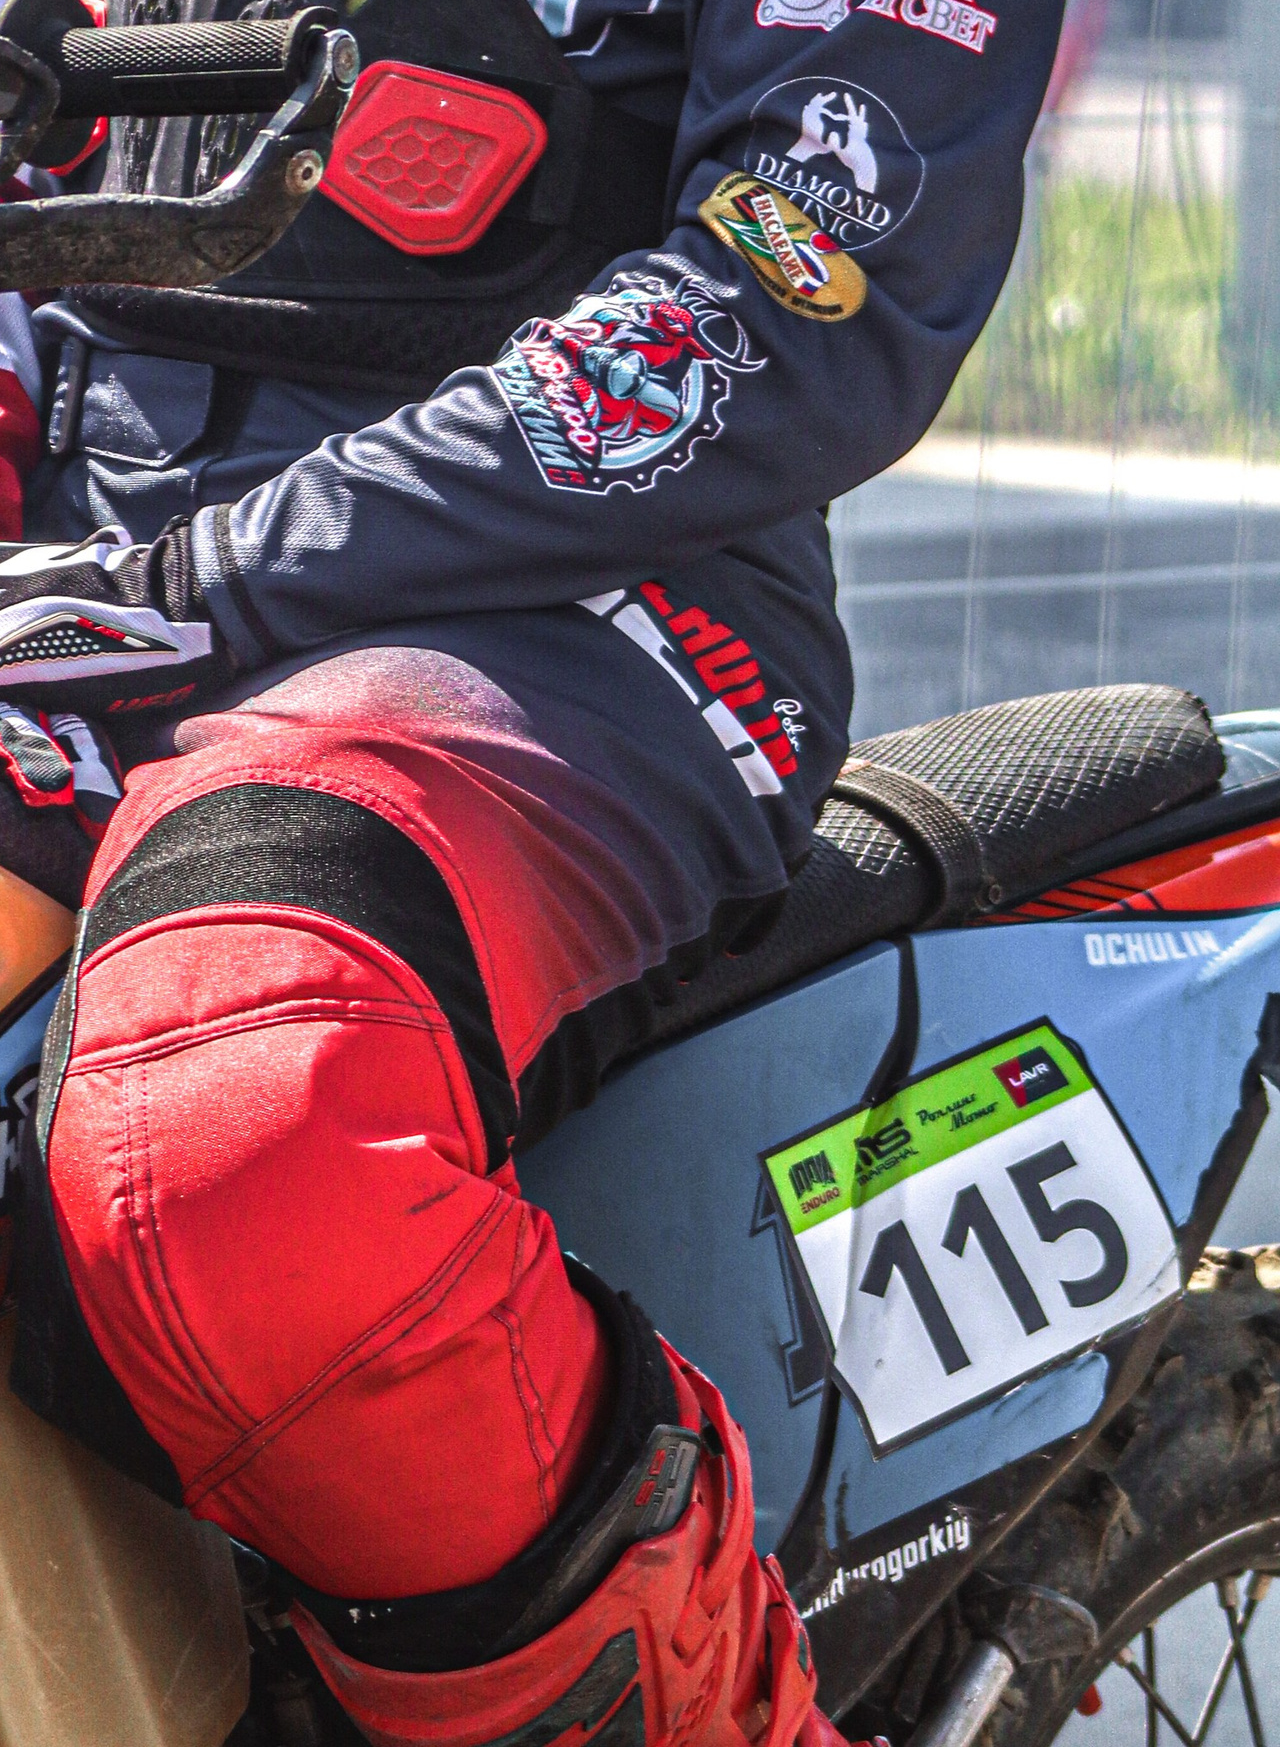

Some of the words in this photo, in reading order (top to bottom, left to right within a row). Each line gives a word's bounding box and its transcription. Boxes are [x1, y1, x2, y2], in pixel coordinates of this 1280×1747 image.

[754, 153, 891, 228] DIAMOND
[1085, 930, 1221, 966] OCHULIN
[1008, 1062, 1050, 1087] LAVR
[801, 1187, 841, 1214] ENDURO
[859, 1141, 1128, 1375] 115
